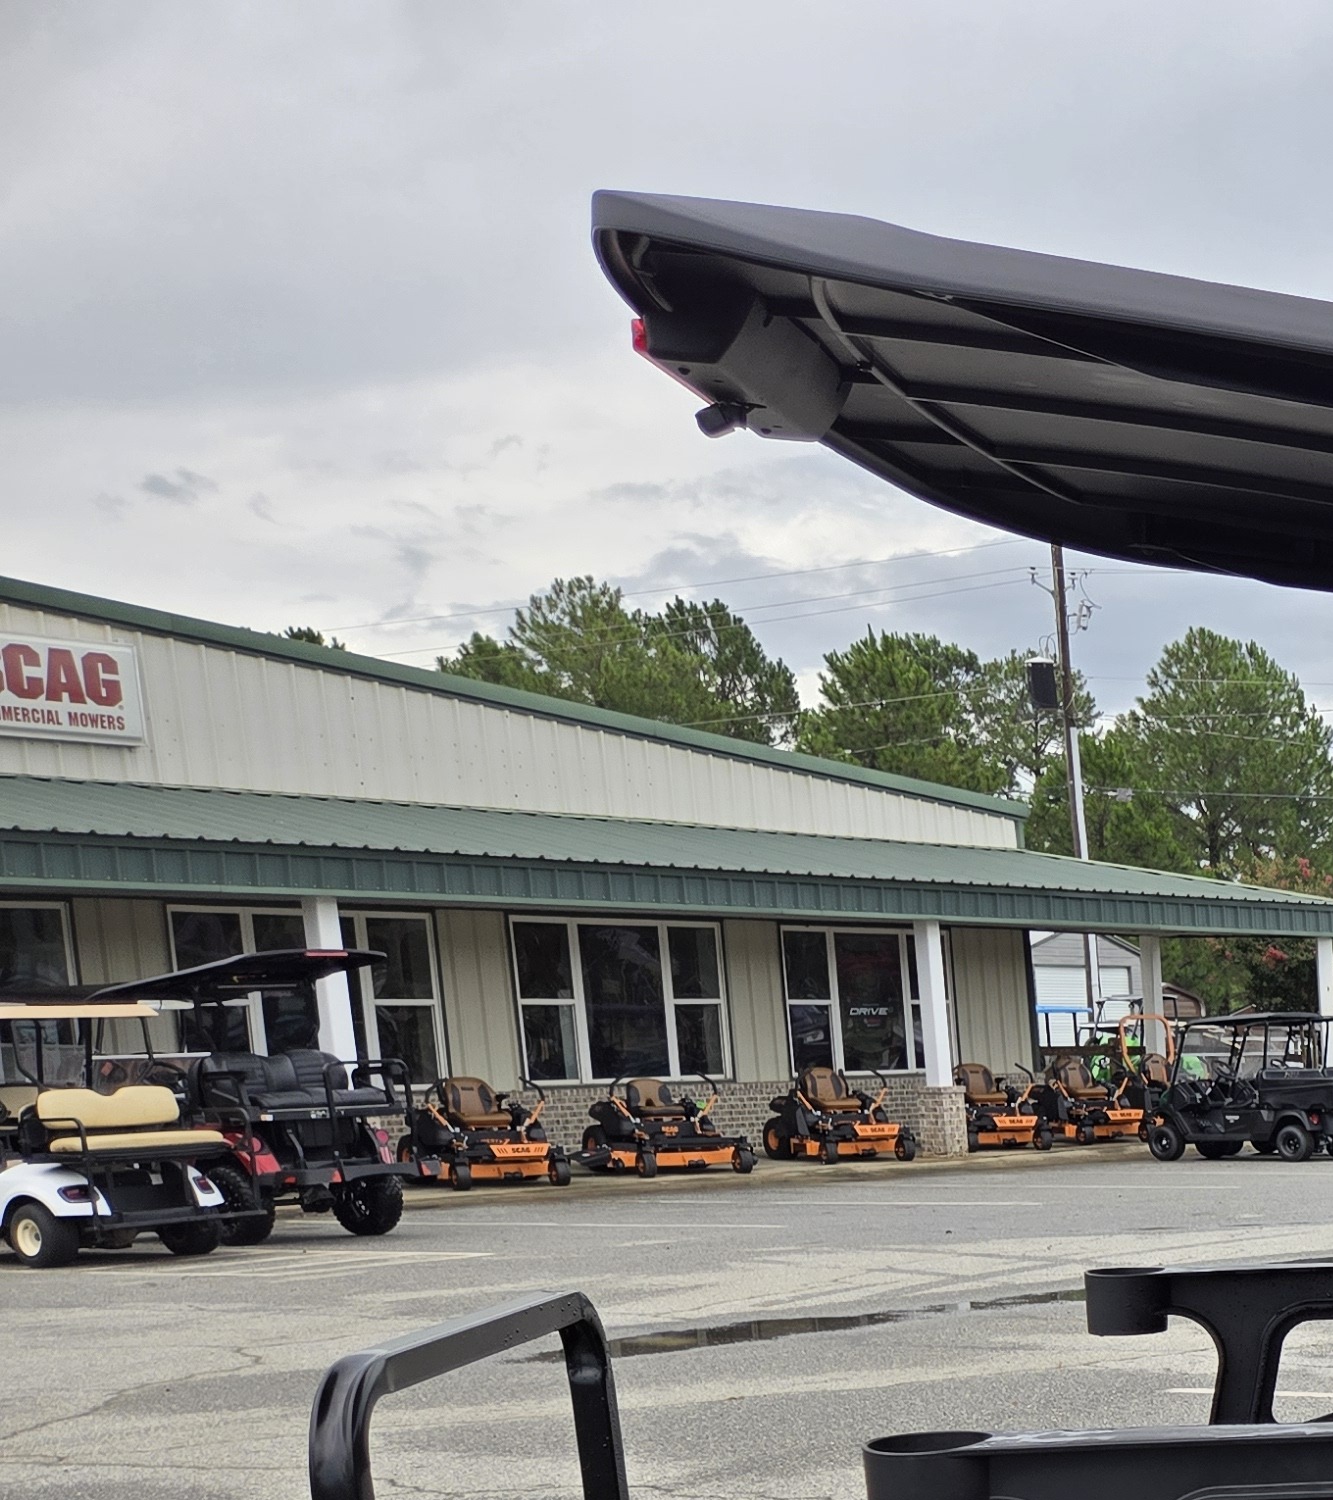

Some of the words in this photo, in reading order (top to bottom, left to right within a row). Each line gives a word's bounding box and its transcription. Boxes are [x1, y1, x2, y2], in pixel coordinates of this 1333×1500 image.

[0, 643, 123, 707] CAG
[0, 705, 63, 726] MERCIAL
[67, 711, 125, 731] MOWERS
